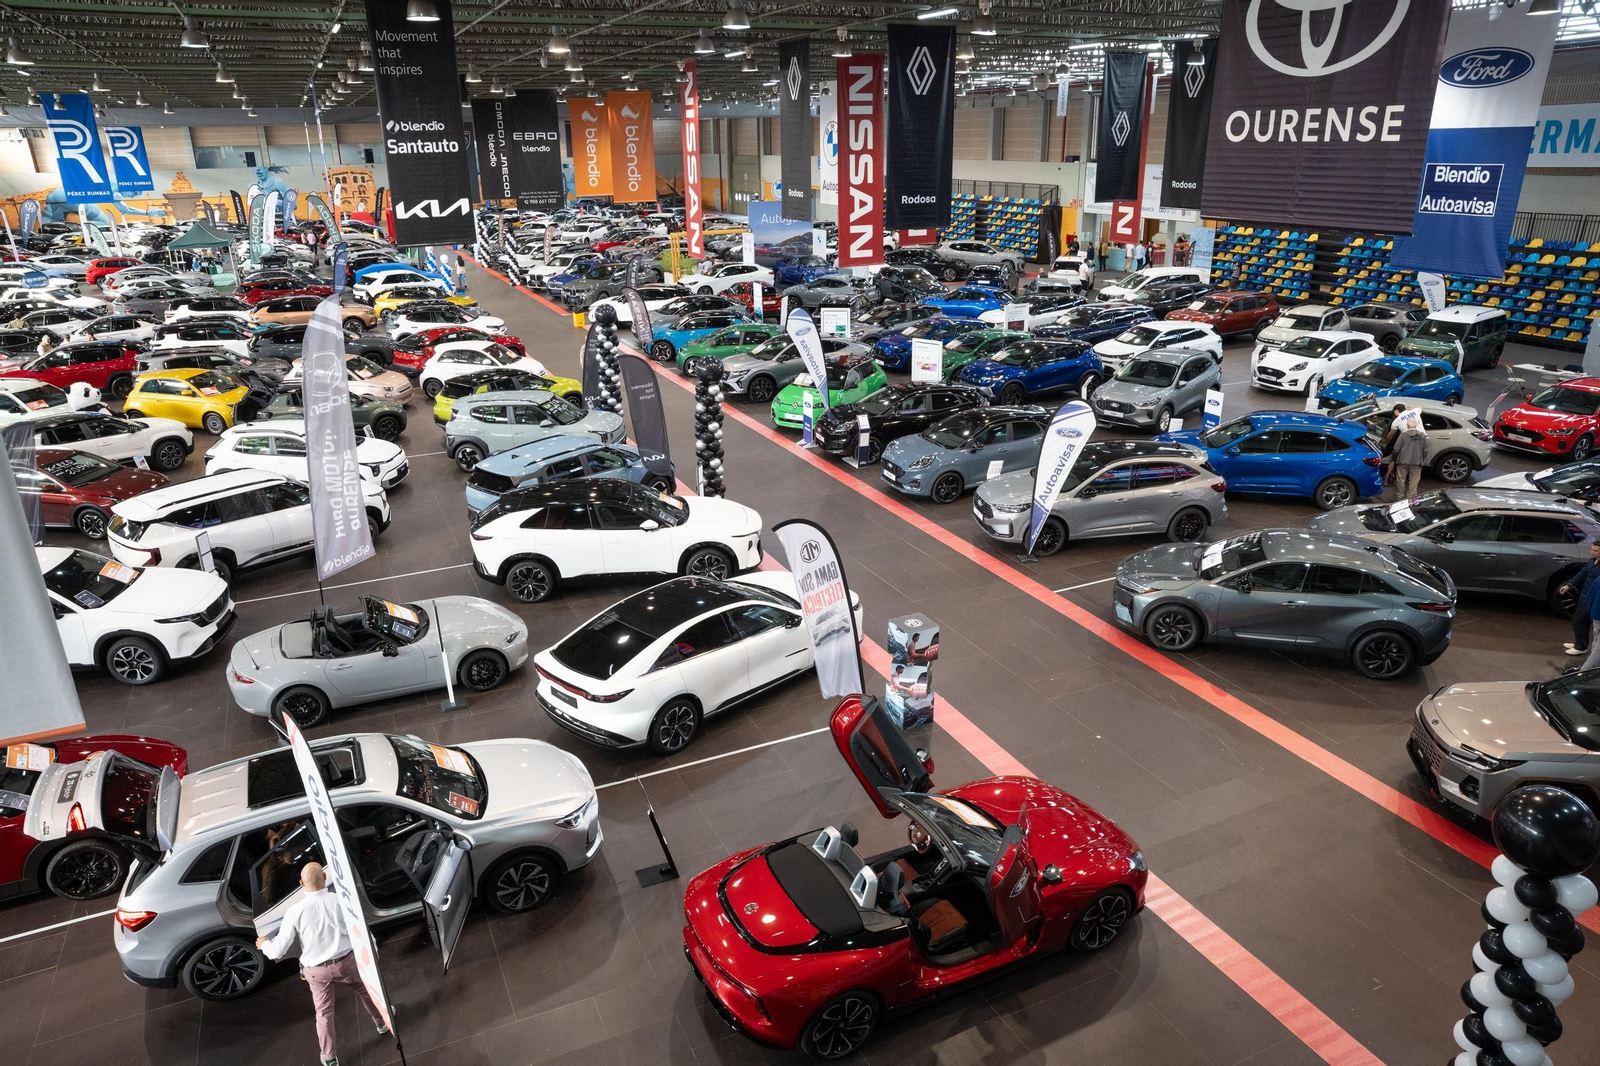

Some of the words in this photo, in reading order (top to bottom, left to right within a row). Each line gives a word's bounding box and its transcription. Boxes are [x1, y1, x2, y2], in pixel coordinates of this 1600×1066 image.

[375, 30, 438, 44] Movement
[378, 47, 402, 59] that
[380, 63, 423, 76] inspires
[1453, 53, 1513, 82] Ford
[400, 120, 445, 132] blendio
[1225, 104, 1406, 143] OURENSE
[388, 138, 459, 154] Santauto
[514, 132, 558, 140] EBRO
[487, 133, 497, 168] blendio
[522, 144, 550, 152] blendio
[585, 128, 599, 187] blendio
[625, 126, 640, 192] blendio
[683, 70, 702, 254] NISSAN
[849, 65, 874, 258] NISSAN
[1171, 180, 1197, 189] Rodosa
[1434, 165, 1490, 184] Blendio
[788, 188, 804, 198] Rodosa
[822, 180, 838, 192] Autog
[395, 198, 470, 220] KIA
[901, 195, 936, 204] Rodosa
[1420, 194, 1496, 215] Autoavisa
[252, 208, 260, 252] SKODA
[1038, 443, 1076, 504] Autoavisa
[330, 497, 346, 538] HIRO
[333, 544, 370, 567] blendio
